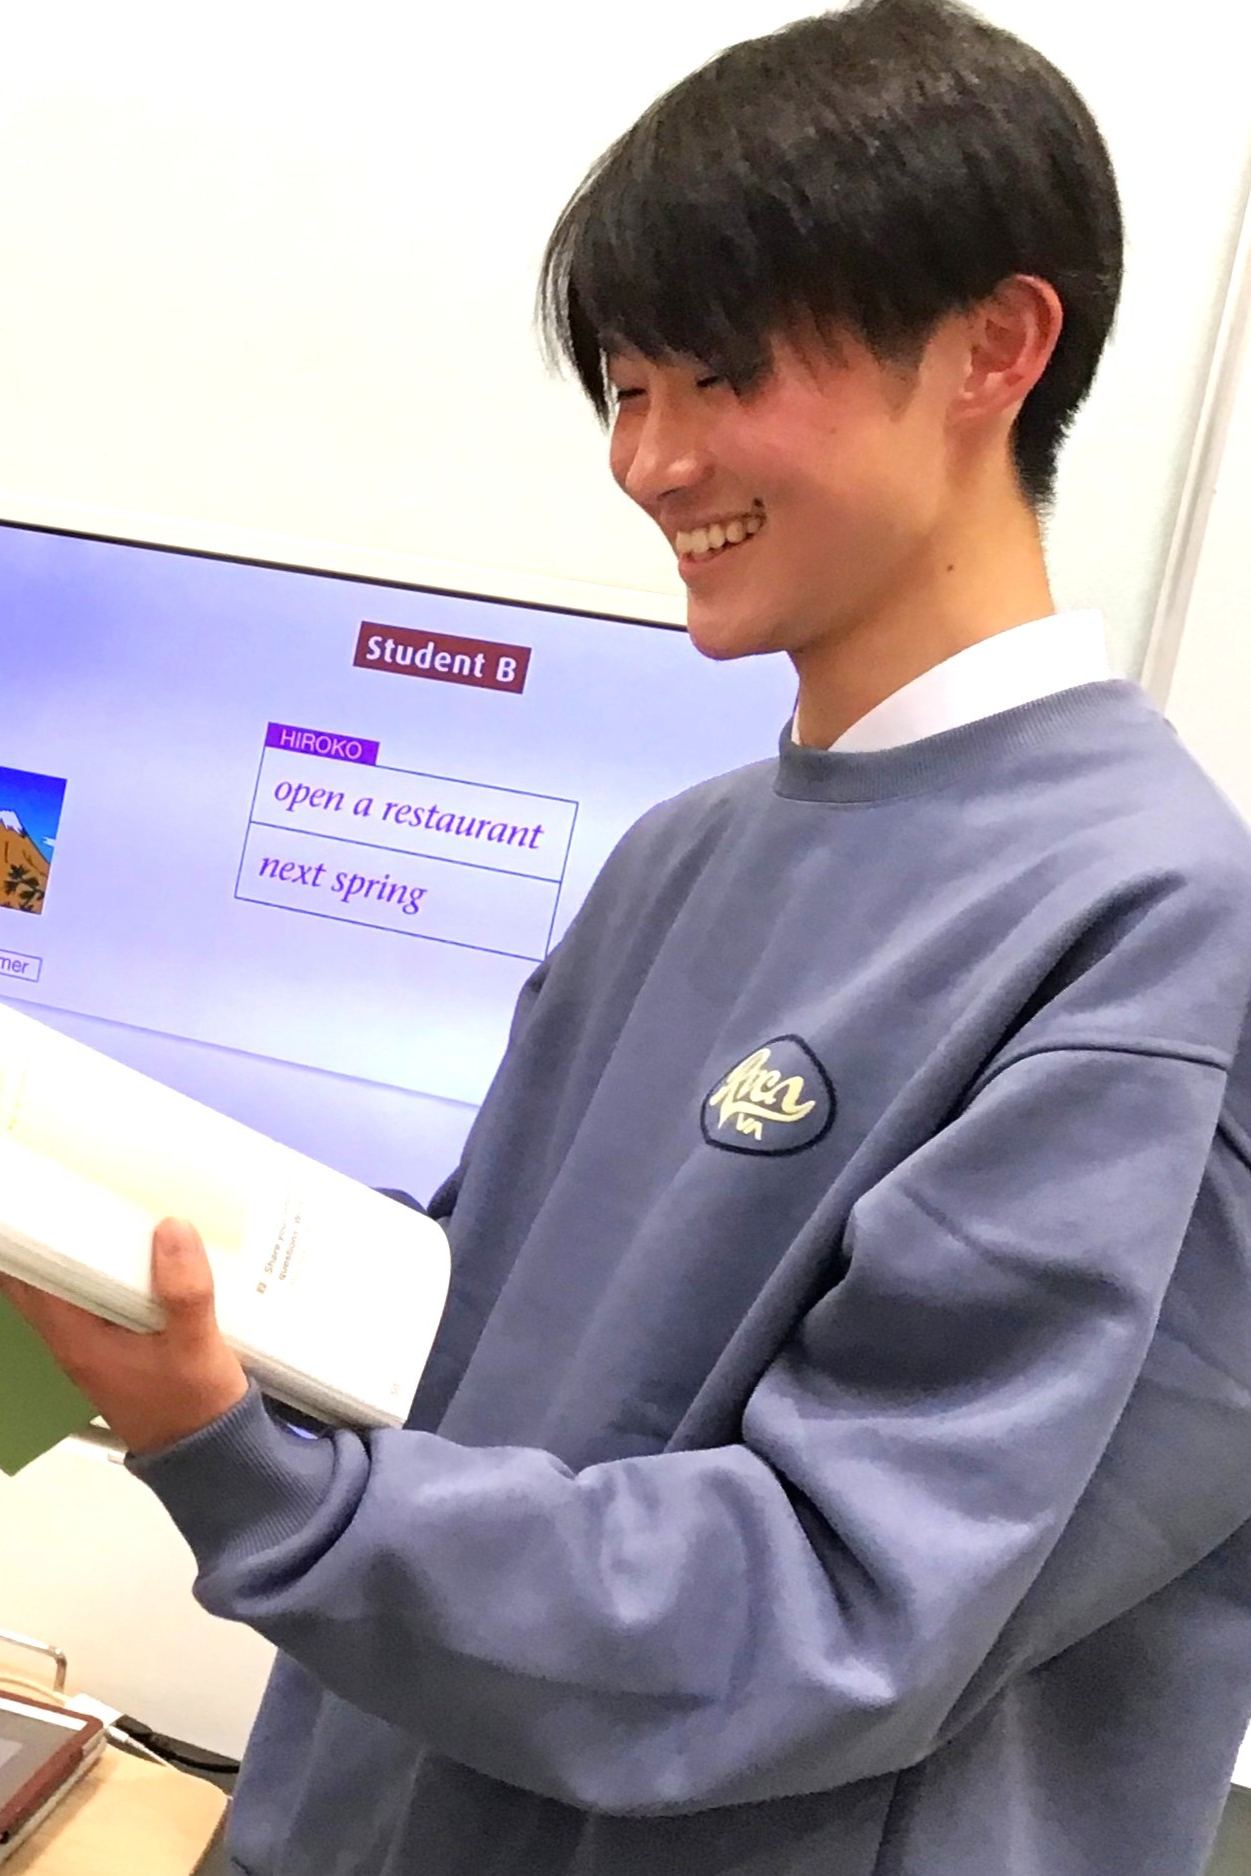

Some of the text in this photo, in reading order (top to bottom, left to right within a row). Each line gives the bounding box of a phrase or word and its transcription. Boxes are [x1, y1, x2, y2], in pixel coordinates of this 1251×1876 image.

[365, 635, 518, 684] Student B
[279, 728, 363, 761] HIROKO
[273, 779, 545, 850] open a restaurant
[258, 853, 428, 915] next spring
